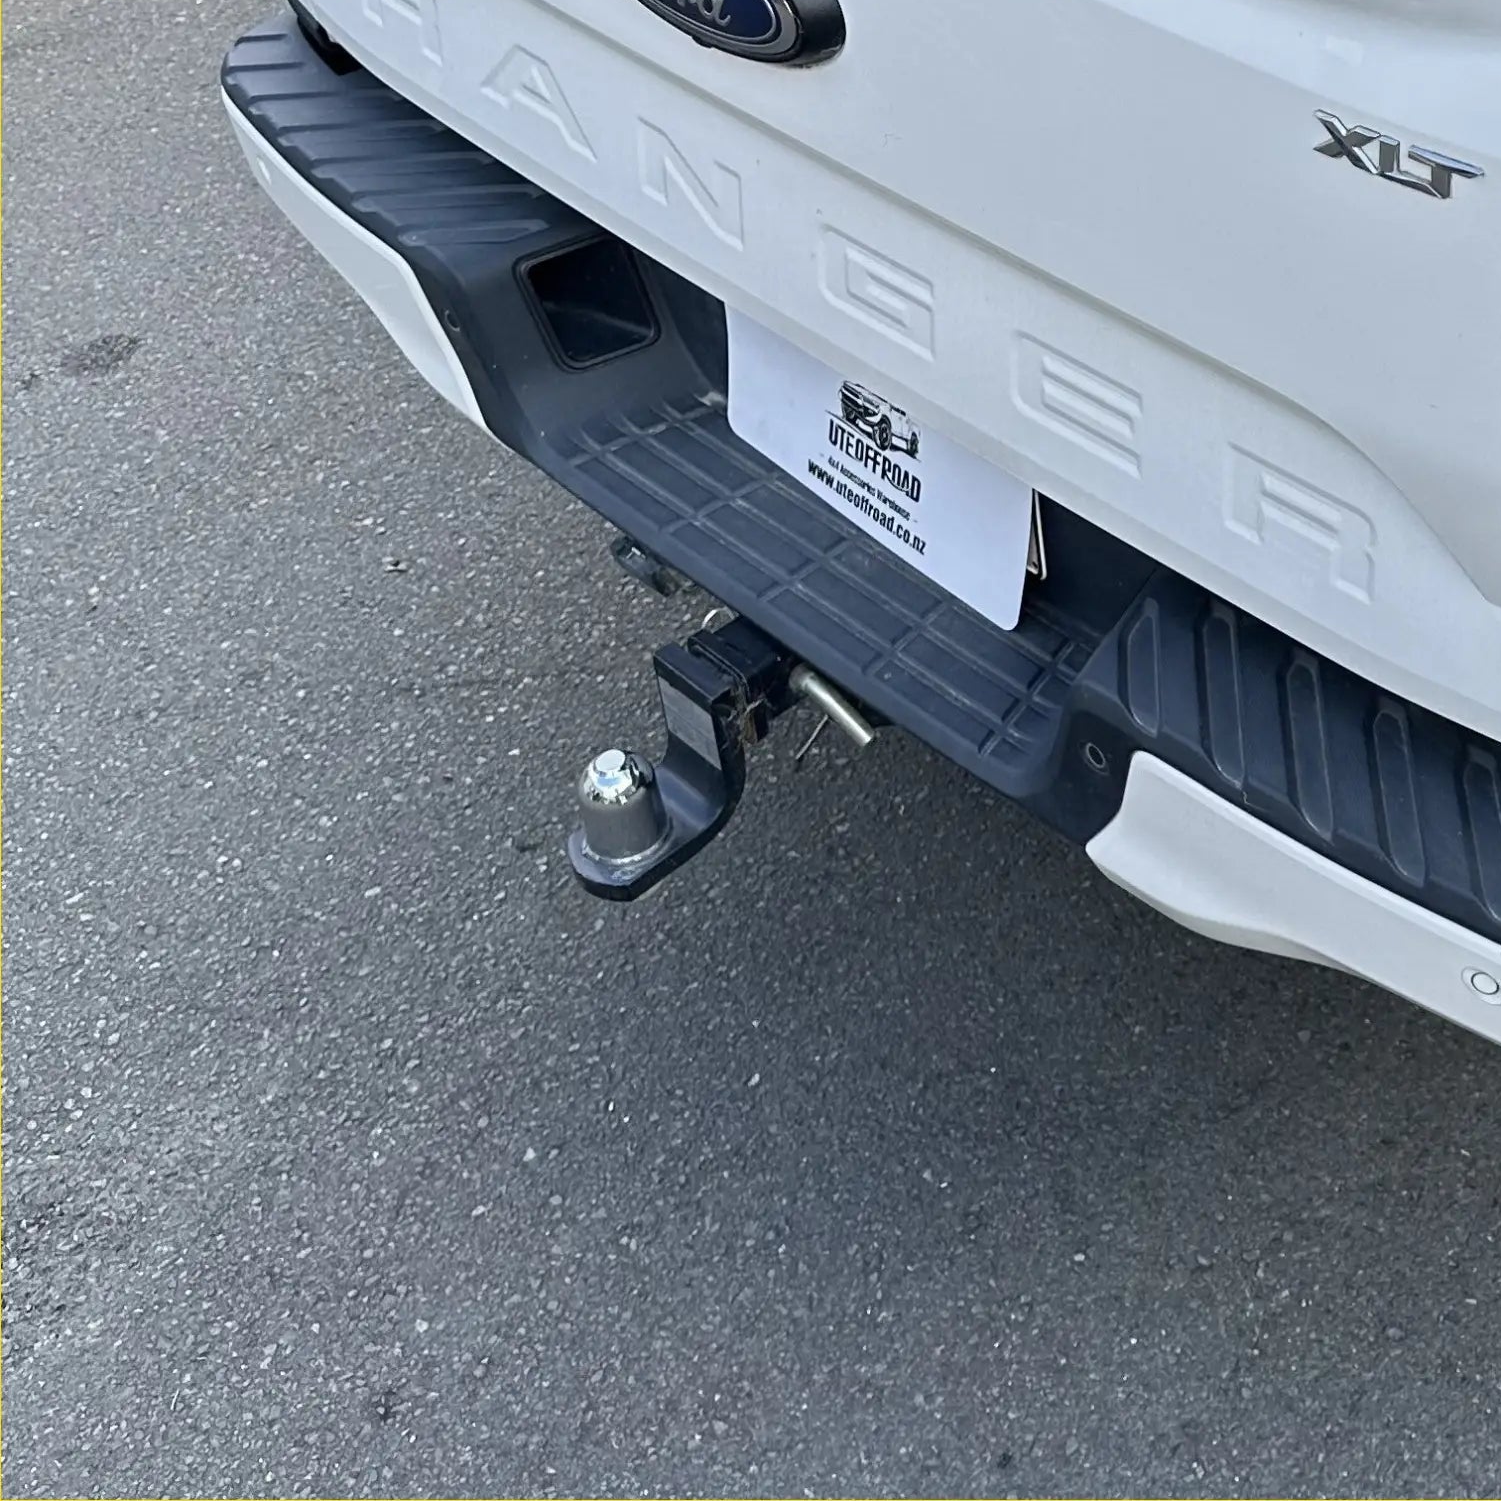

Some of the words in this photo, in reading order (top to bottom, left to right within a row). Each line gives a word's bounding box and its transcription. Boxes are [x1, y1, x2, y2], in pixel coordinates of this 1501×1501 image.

[1312, 108, 1485, 200] XLT
[828, 418, 922, 504] UTEOFFROAD
[807, 458, 928, 557] www.uteoffroad.co.nz
